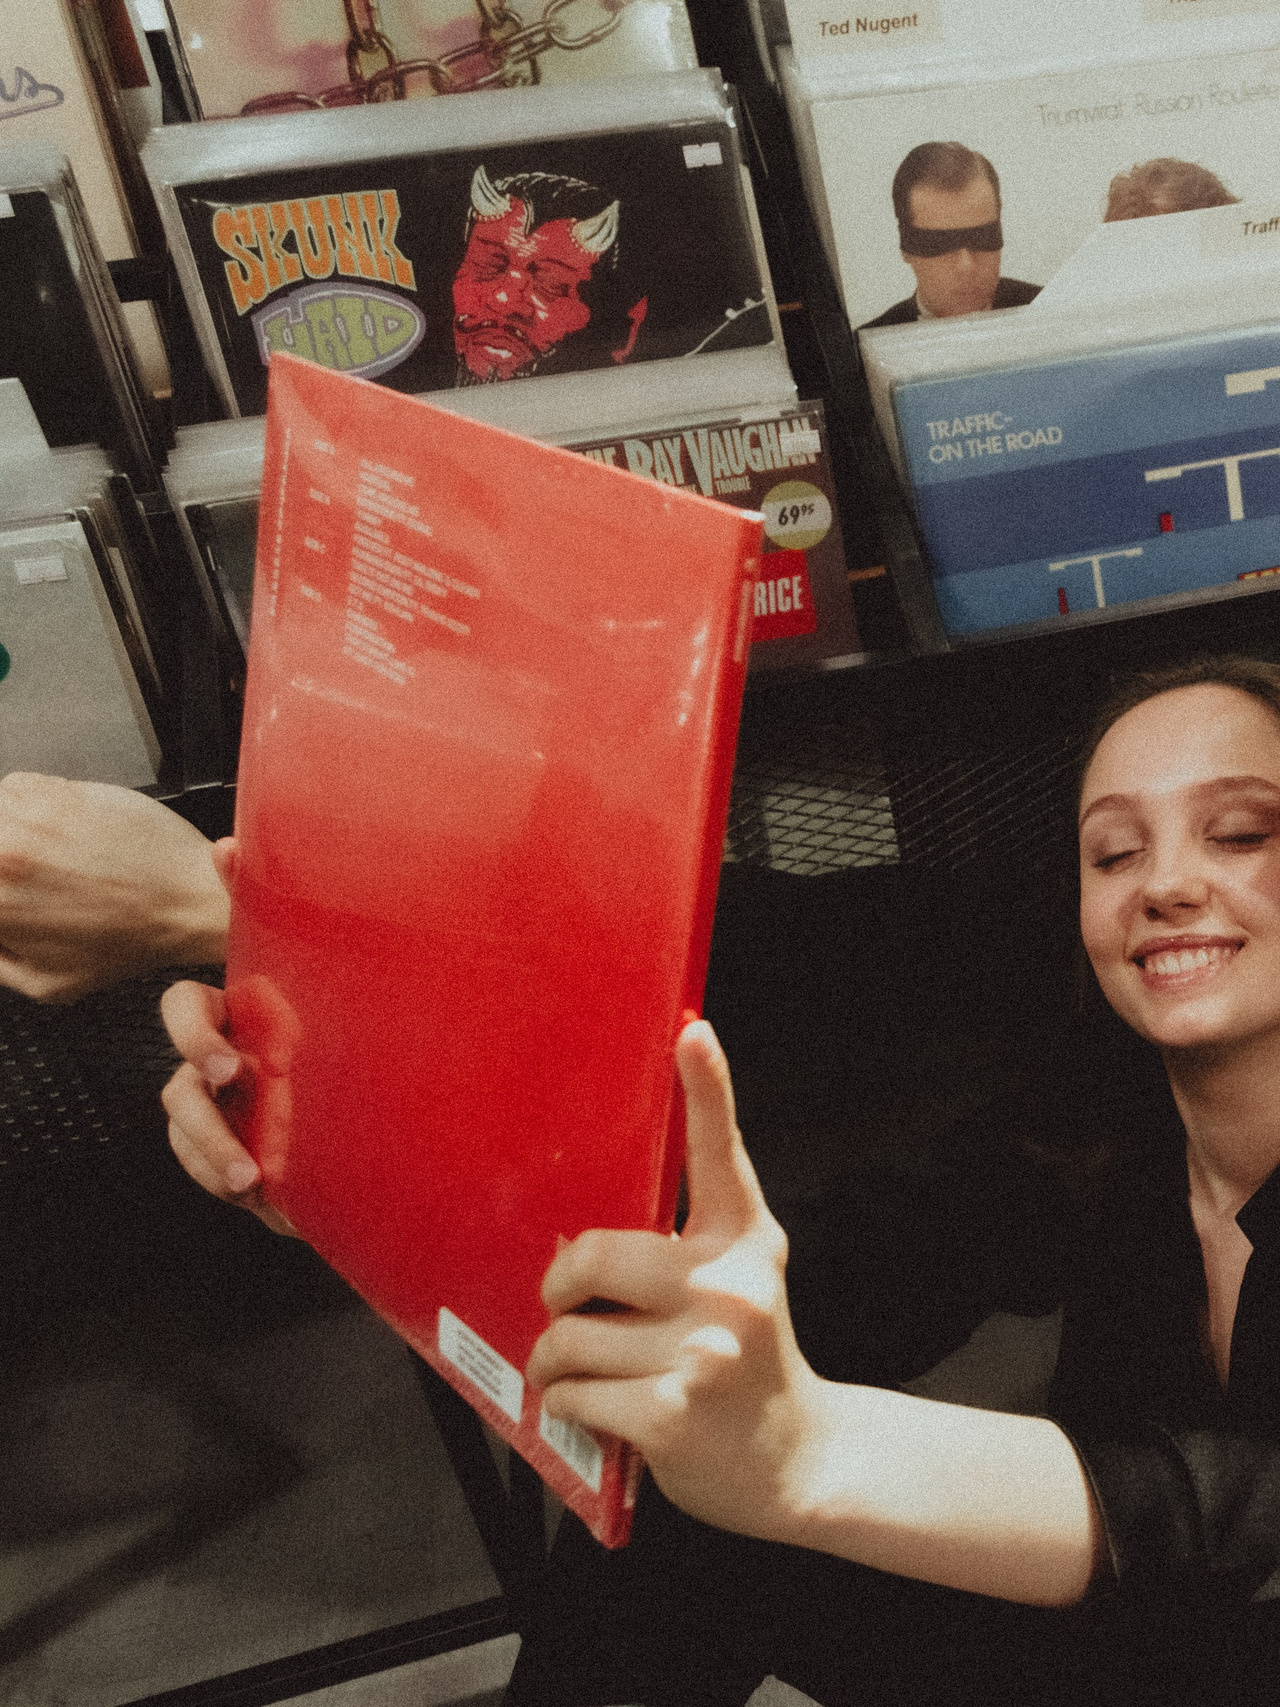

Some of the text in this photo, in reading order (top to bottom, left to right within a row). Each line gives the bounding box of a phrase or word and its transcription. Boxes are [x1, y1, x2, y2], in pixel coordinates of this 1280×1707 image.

[819, 13, 919, 37] Ted Nugent
[212, 188, 418, 317] SKUNK
[623, 436, 687, 486] RAY
[928, 425, 1063, 465] ON THE ROAD
[753, 575, 804, 618] RICE
